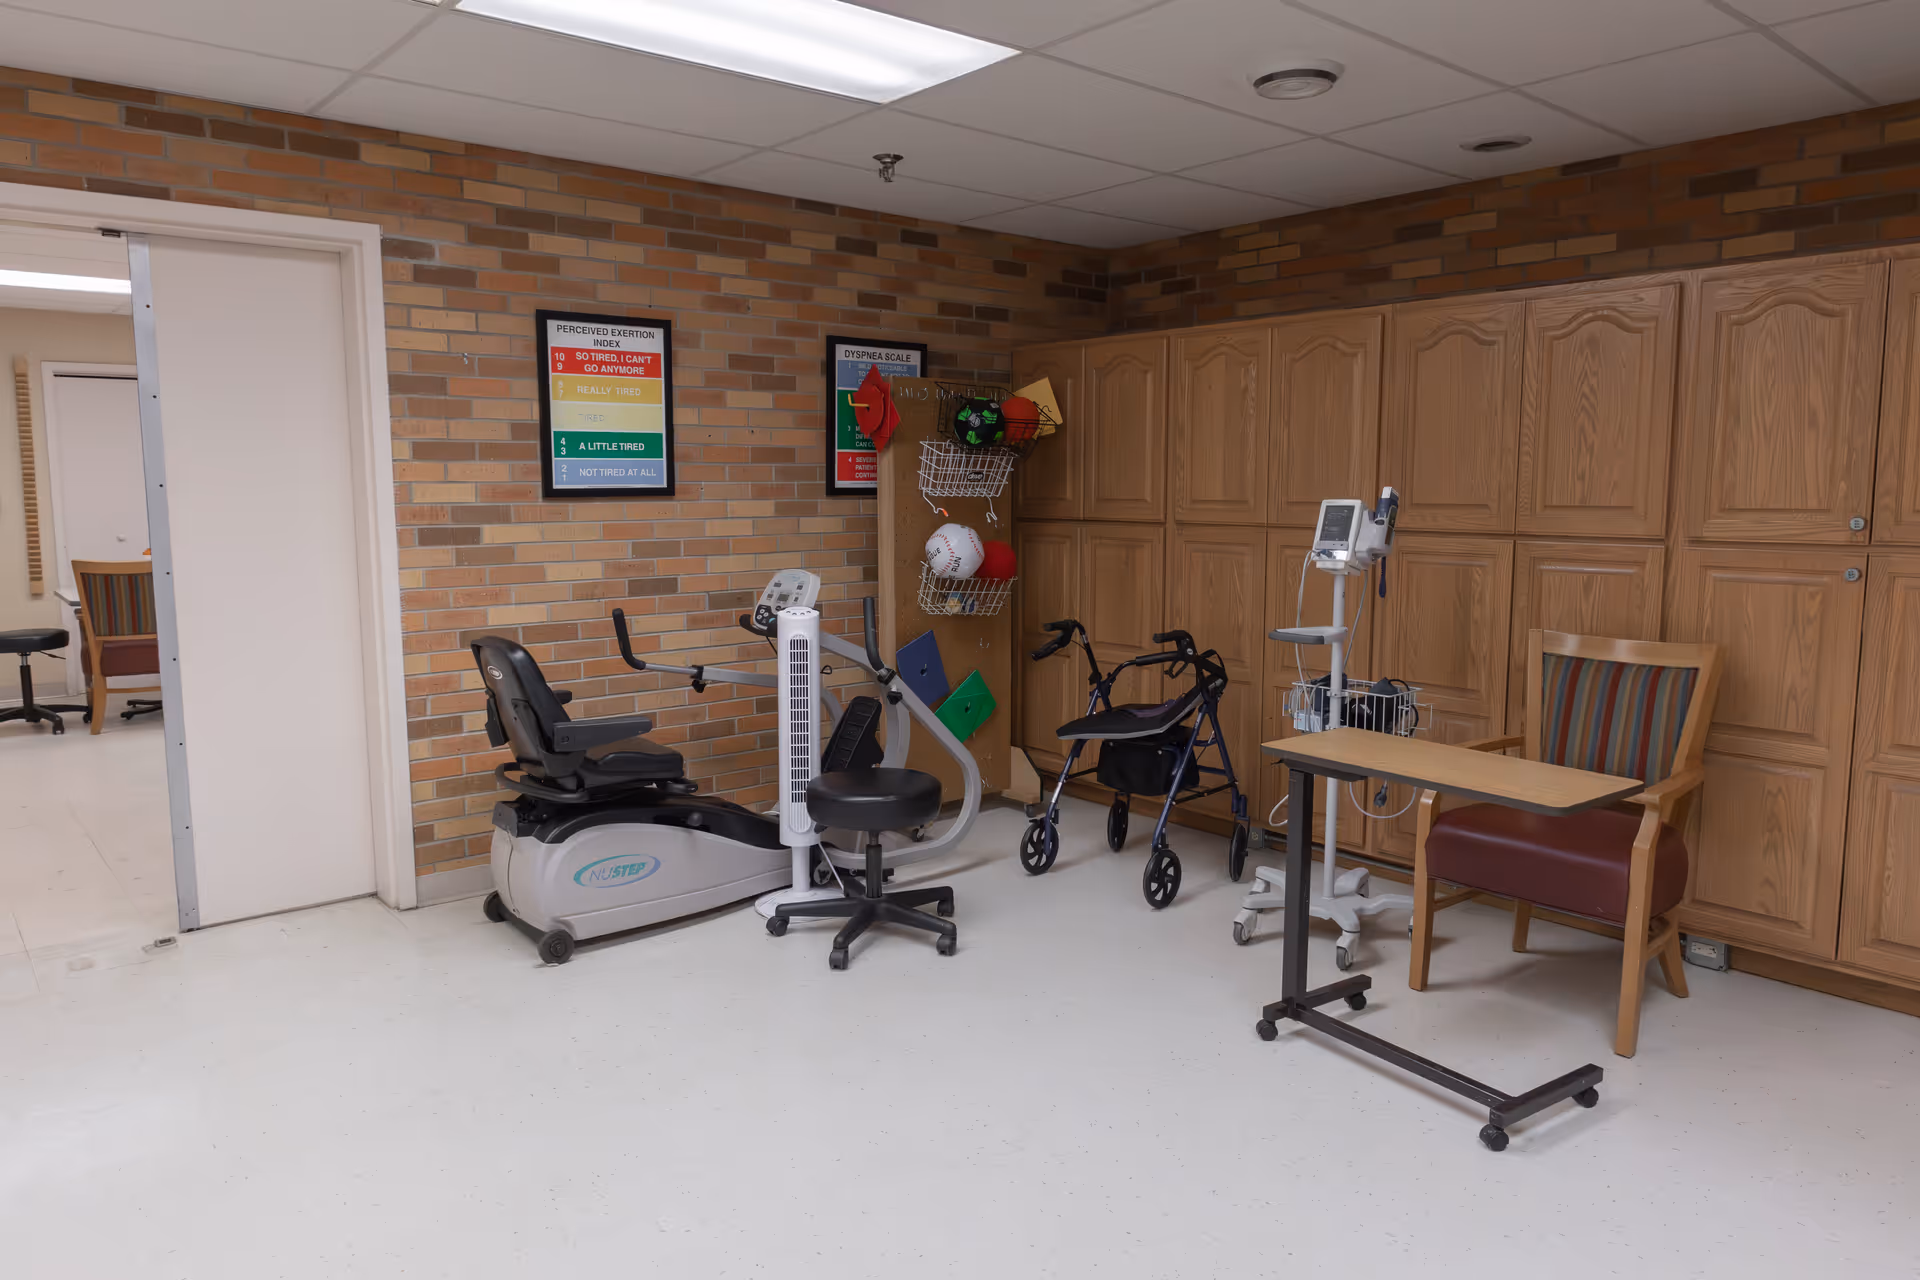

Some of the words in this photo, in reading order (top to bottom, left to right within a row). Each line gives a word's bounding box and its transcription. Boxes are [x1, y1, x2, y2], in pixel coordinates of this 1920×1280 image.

[556, 324, 608, 336] PERCEIVED
[611, 328, 655, 339] EXERTION
[593, 338, 621, 348] INDEX
[554, 352, 565, 361] 10
[575, 351, 589, 361] SO
[590, 352, 620, 364] TIRED,
[620, 354, 624, 362] I
[625, 355, 652, 364] CAN'T
[844, 349, 883, 361] DYSPNEA
[885, 352, 912, 363] SCALE
[557, 362, 563, 371] 9
[584, 364, 599, 373] GO
[600, 365, 645, 375] ANYMORE
[577, 385, 612, 395] REALLY
[615, 387, 641, 396] TIRED
[560, 437, 566, 445] 4
[560, 447, 566, 455] 3
[579, 442, 586, 450] A
[588, 442, 618, 451] LITTLE
[619, 442, 645, 451] TIRED
[561, 464, 567, 473] 2
[579, 468, 598, 477] NOT
[599, 468, 626, 477] TIRED
[627, 468, 638, 477] AT
[640, 468, 657, 477] ALL
[951, 556, 962, 573] RUN
